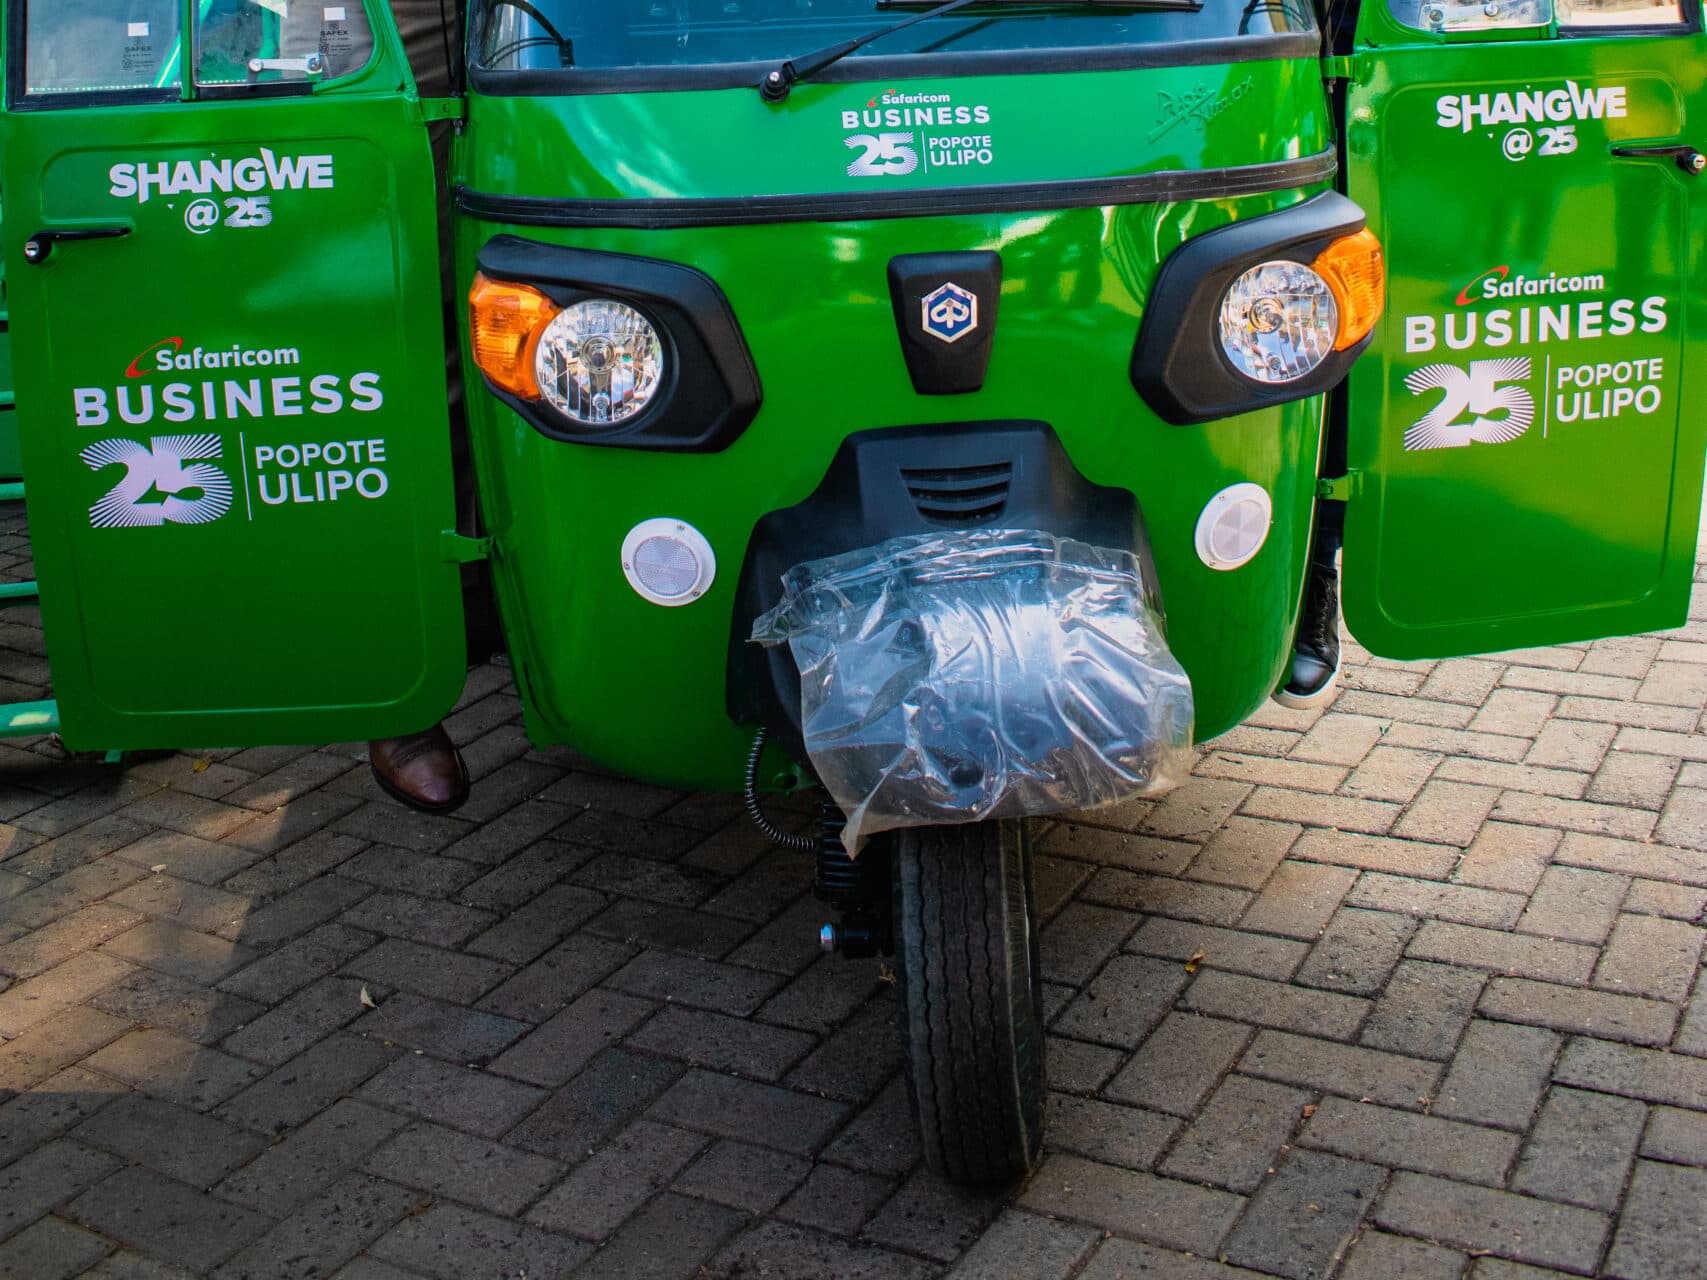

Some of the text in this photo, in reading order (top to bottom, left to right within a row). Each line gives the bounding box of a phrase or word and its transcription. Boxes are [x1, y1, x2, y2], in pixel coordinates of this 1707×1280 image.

[841, 105, 991, 129] BUSINESS
[882, 93, 950, 105] Safaricom
[1436, 80, 1627, 134] SHANGWE
[843, 132, 918, 177] 25
[929, 135, 992, 149] POPOTE
[930, 149, 993, 166] ULIPO
[1502, 124, 1578, 161] @ 25
[109, 147, 334, 204] SHANGWE
[184, 195, 273, 234] @ 25
[1482, 272, 1604, 299] Safaricom
[1405, 296, 1668, 353] BUSINESS
[155, 344, 300, 371] Safaricom
[1556, 358, 1664, 390] POPOTE
[73, 372, 384, 426] BUSINESS
[1403, 356, 1535, 451] 25
[1556, 384, 1662, 423] ULIPO
[255, 438, 387, 470] POPOTE
[79, 433, 233, 529] 25
[258, 467, 389, 505] ULIPO
